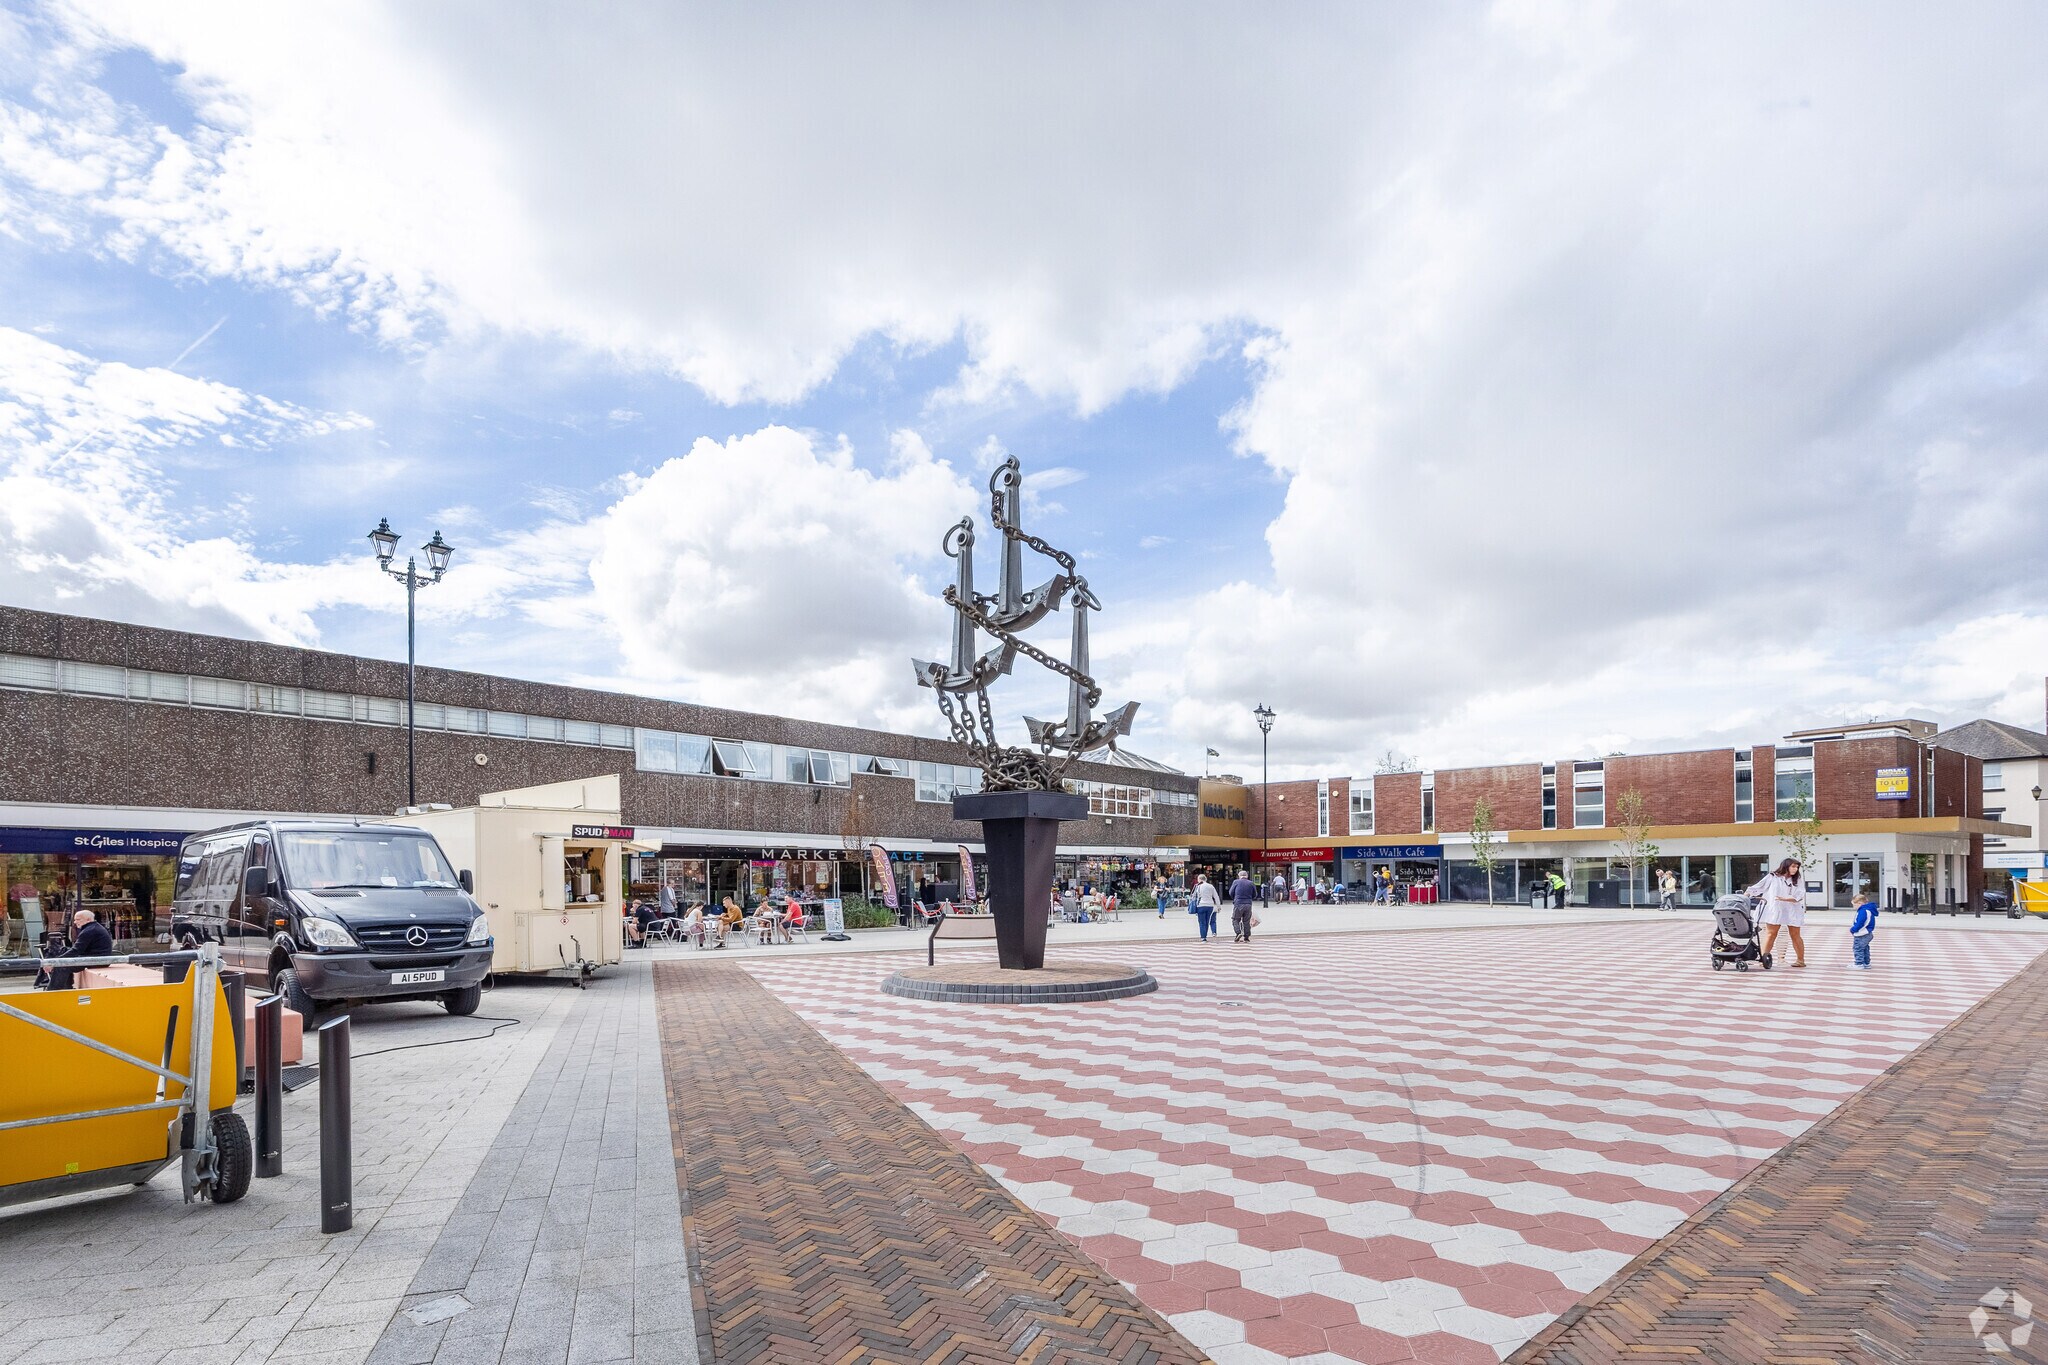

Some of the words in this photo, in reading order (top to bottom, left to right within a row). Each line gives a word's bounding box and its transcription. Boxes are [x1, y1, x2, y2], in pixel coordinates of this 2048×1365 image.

[1204, 802, 1226, 819] Middle
[1228, 804, 1244, 824] Entry
[574, 827, 602, 836] SPUD
[610, 829, 632, 838] MAN
[74, 836, 90, 846] St
[90, 834, 124, 848] Giles
[130, 838, 178, 848] Hospice
[864, 850, 924, 860] PACE
[1357, 848, 1376, 858] Side
[1380, 848, 1402, 857] Walk
[1405, 847, 1425, 856] Café
[413, 972, 437, 981] SPUD
